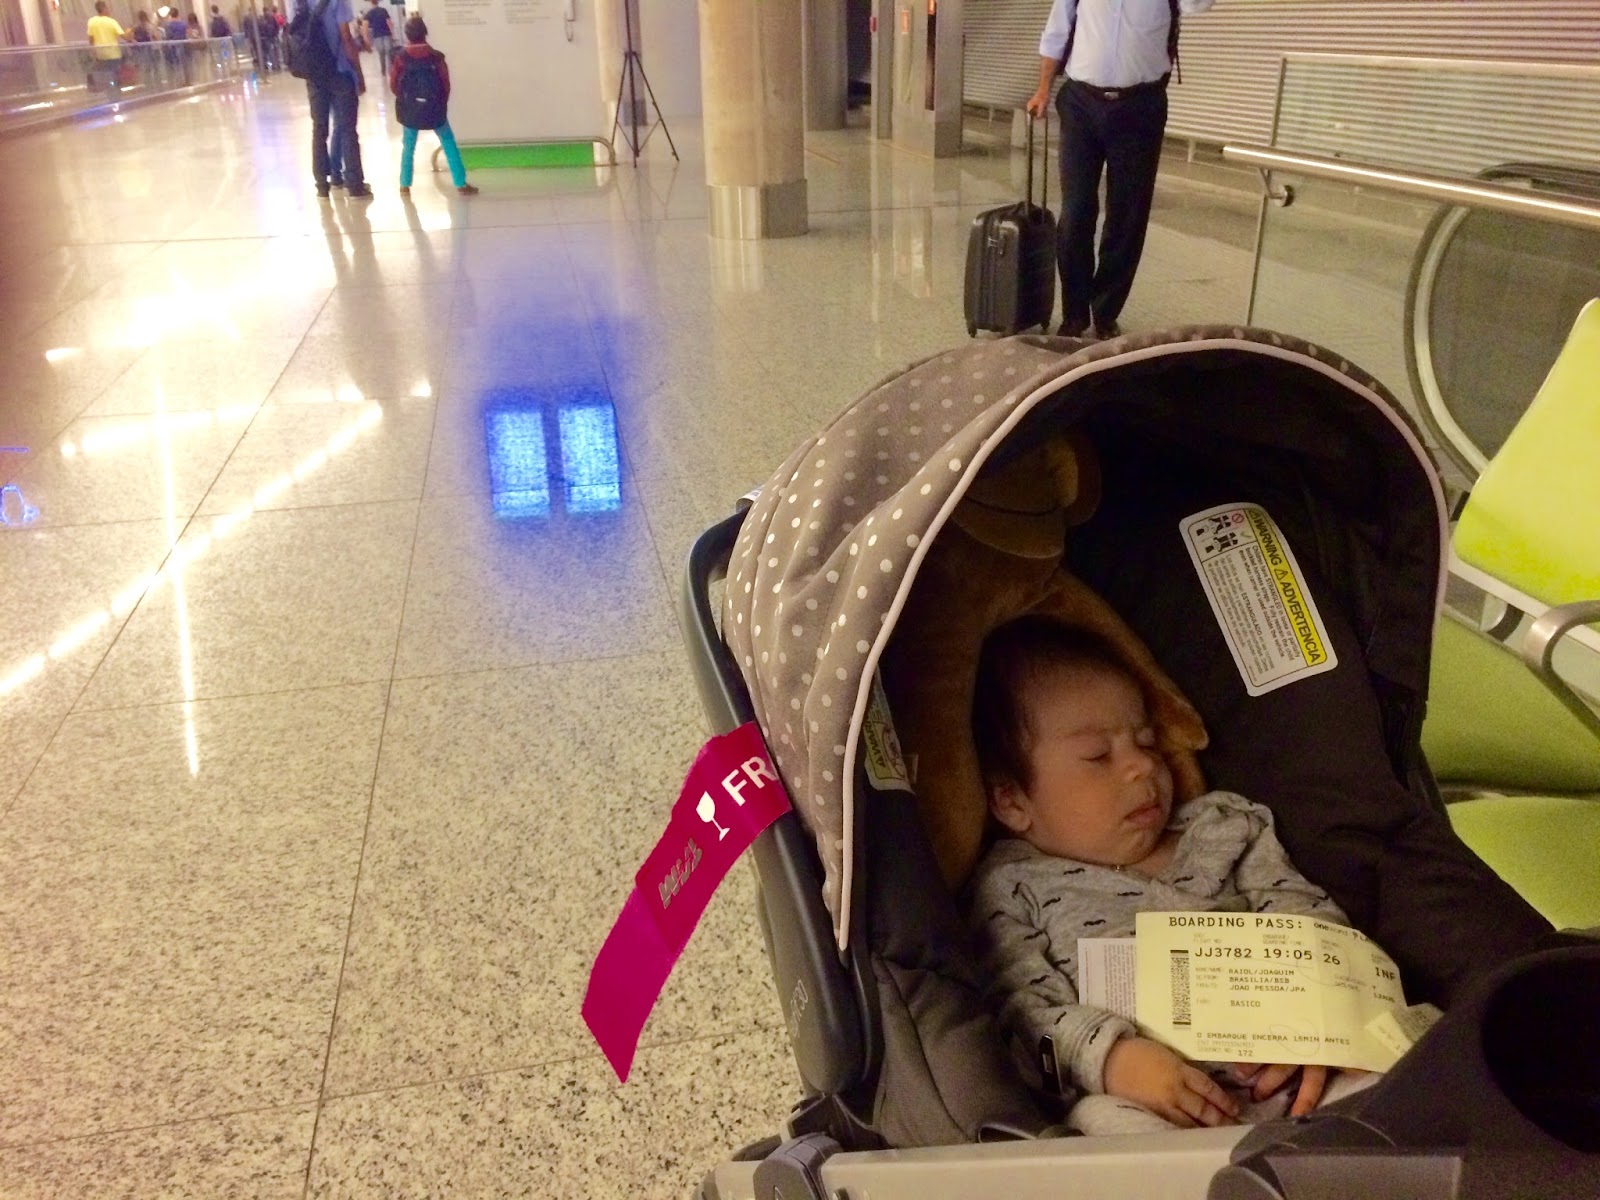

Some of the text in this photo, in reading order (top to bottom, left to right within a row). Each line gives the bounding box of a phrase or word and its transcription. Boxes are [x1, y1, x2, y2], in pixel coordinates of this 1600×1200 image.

[1253, 518, 1283, 566] WARNING
[1281, 582, 1321, 663] ADVERTENCIA
[721, 756, 779, 806] FR
[1169, 916, 1245, 928] BOARDING
[1255, 918, 1302, 929] PASS:
[1194, 947, 1396, 980] JJ3782 19:05 26 INF
[1229, 976, 1290, 984] BRASILIA/BSB
[1254, 985, 1306, 993] PESSOA/JPA
[1230, 1000, 1261, 1008] BASICO
[1206, 1032, 1247, 1040] EMBARQUE
[1252, 1033, 1288, 1042] ENCERRA
[1324, 1037, 1351, 1046] ANTES
[1237, 1049, 1253, 1057] 172
